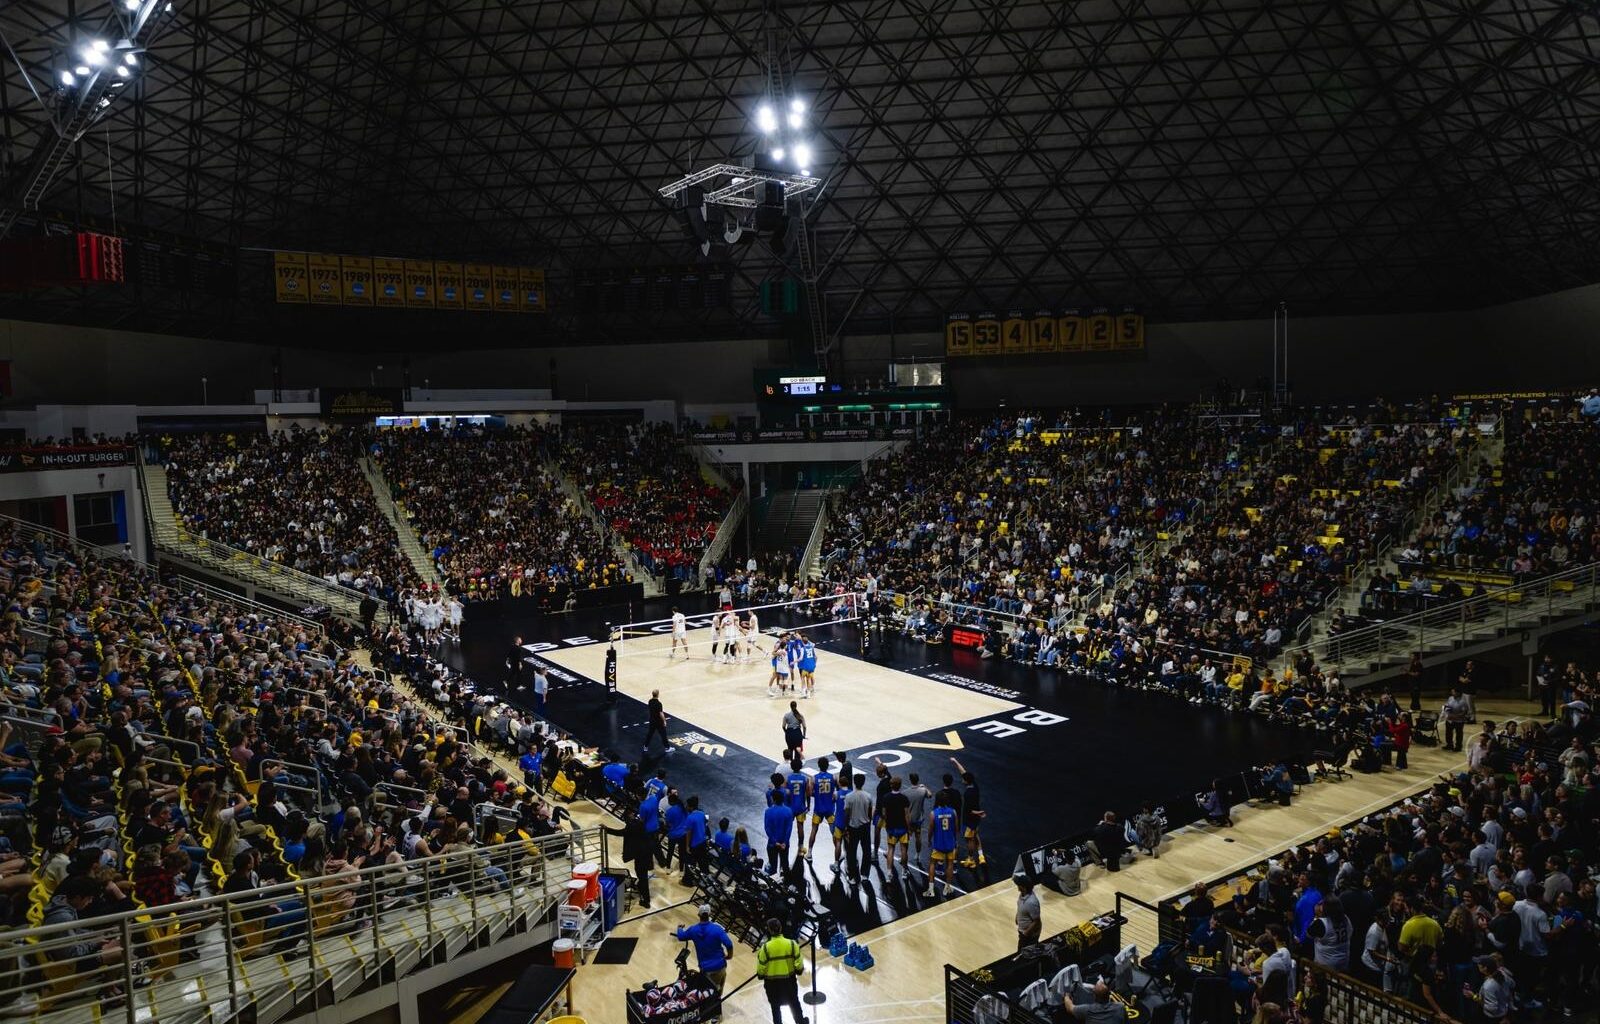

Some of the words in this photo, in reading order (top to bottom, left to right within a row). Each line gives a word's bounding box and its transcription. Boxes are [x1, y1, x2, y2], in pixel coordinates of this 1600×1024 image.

[278, 267, 305, 279] 1972
[344, 271, 370, 282] 1989
[407, 275, 432, 286] 1998
[438, 276, 461, 287] 1991
[466, 278, 490, 288] 2018
[495, 279, 517, 289] 2019
[976, 324, 999, 344] 53
[1009, 323, 1020, 344] 4
[1034, 321, 1052, 343] 14
[1066, 321, 1077, 341] 7
[1094, 320, 1106, 340] 2
[1123, 318, 1136, 338] 5
[951, 325, 969, 346] 15
[783, 385, 789, 393] 3
[819, 384, 825, 392] 4
[42, 454, 87, 464] IN-N-OUT
[89, 453, 124, 462] BURGER
[608, 661, 616, 693] BEACH
[793, 783, 800, 795] 2
[819, 782, 831, 794] 20
[942, 818, 949, 831] 9
[667, 1009, 700, 1024] molten
